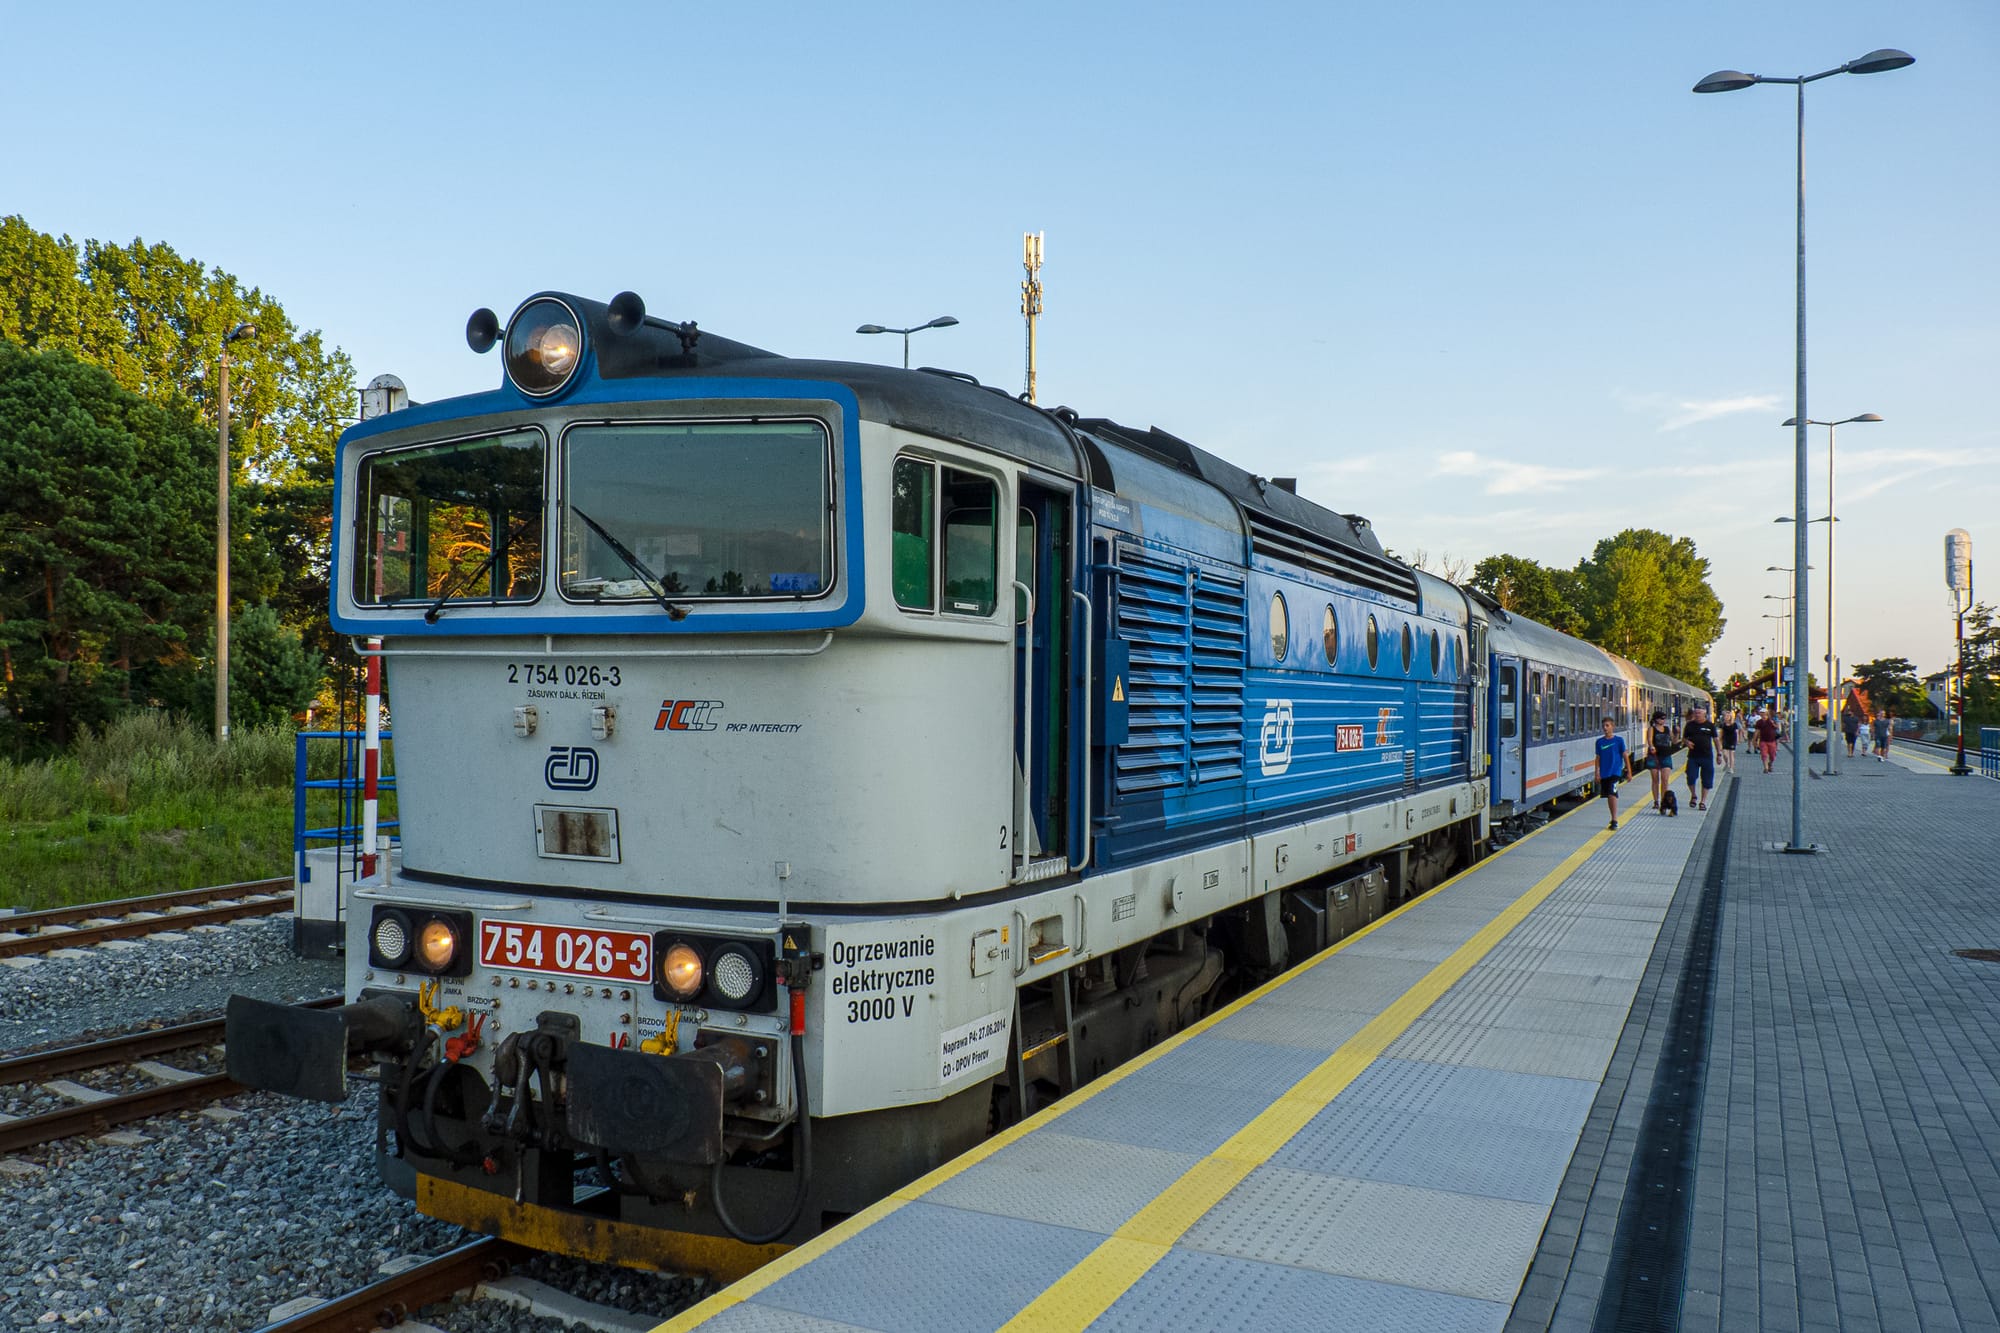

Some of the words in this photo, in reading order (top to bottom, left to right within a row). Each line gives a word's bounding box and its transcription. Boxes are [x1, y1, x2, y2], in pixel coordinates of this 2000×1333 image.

[507, 664, 519, 683] 2
[523, 664, 558, 685] 754
[565, 665, 621, 686] 026-3
[725, 723, 748, 732] PKP
[749, 724, 802, 733] INTERCITY
[544, 745, 600, 792] ČD
[1000, 825, 1007, 849] 2
[484, 925, 544, 967] 754
[555, 932, 648, 978] 026-3
[832, 934, 935, 968] Ogrzewanie
[832, 967, 935, 994] elektryczne
[847, 997, 895, 1023] 3000
[902, 994, 914, 1018] V
[943, 1036, 968, 1055] Naprawa
